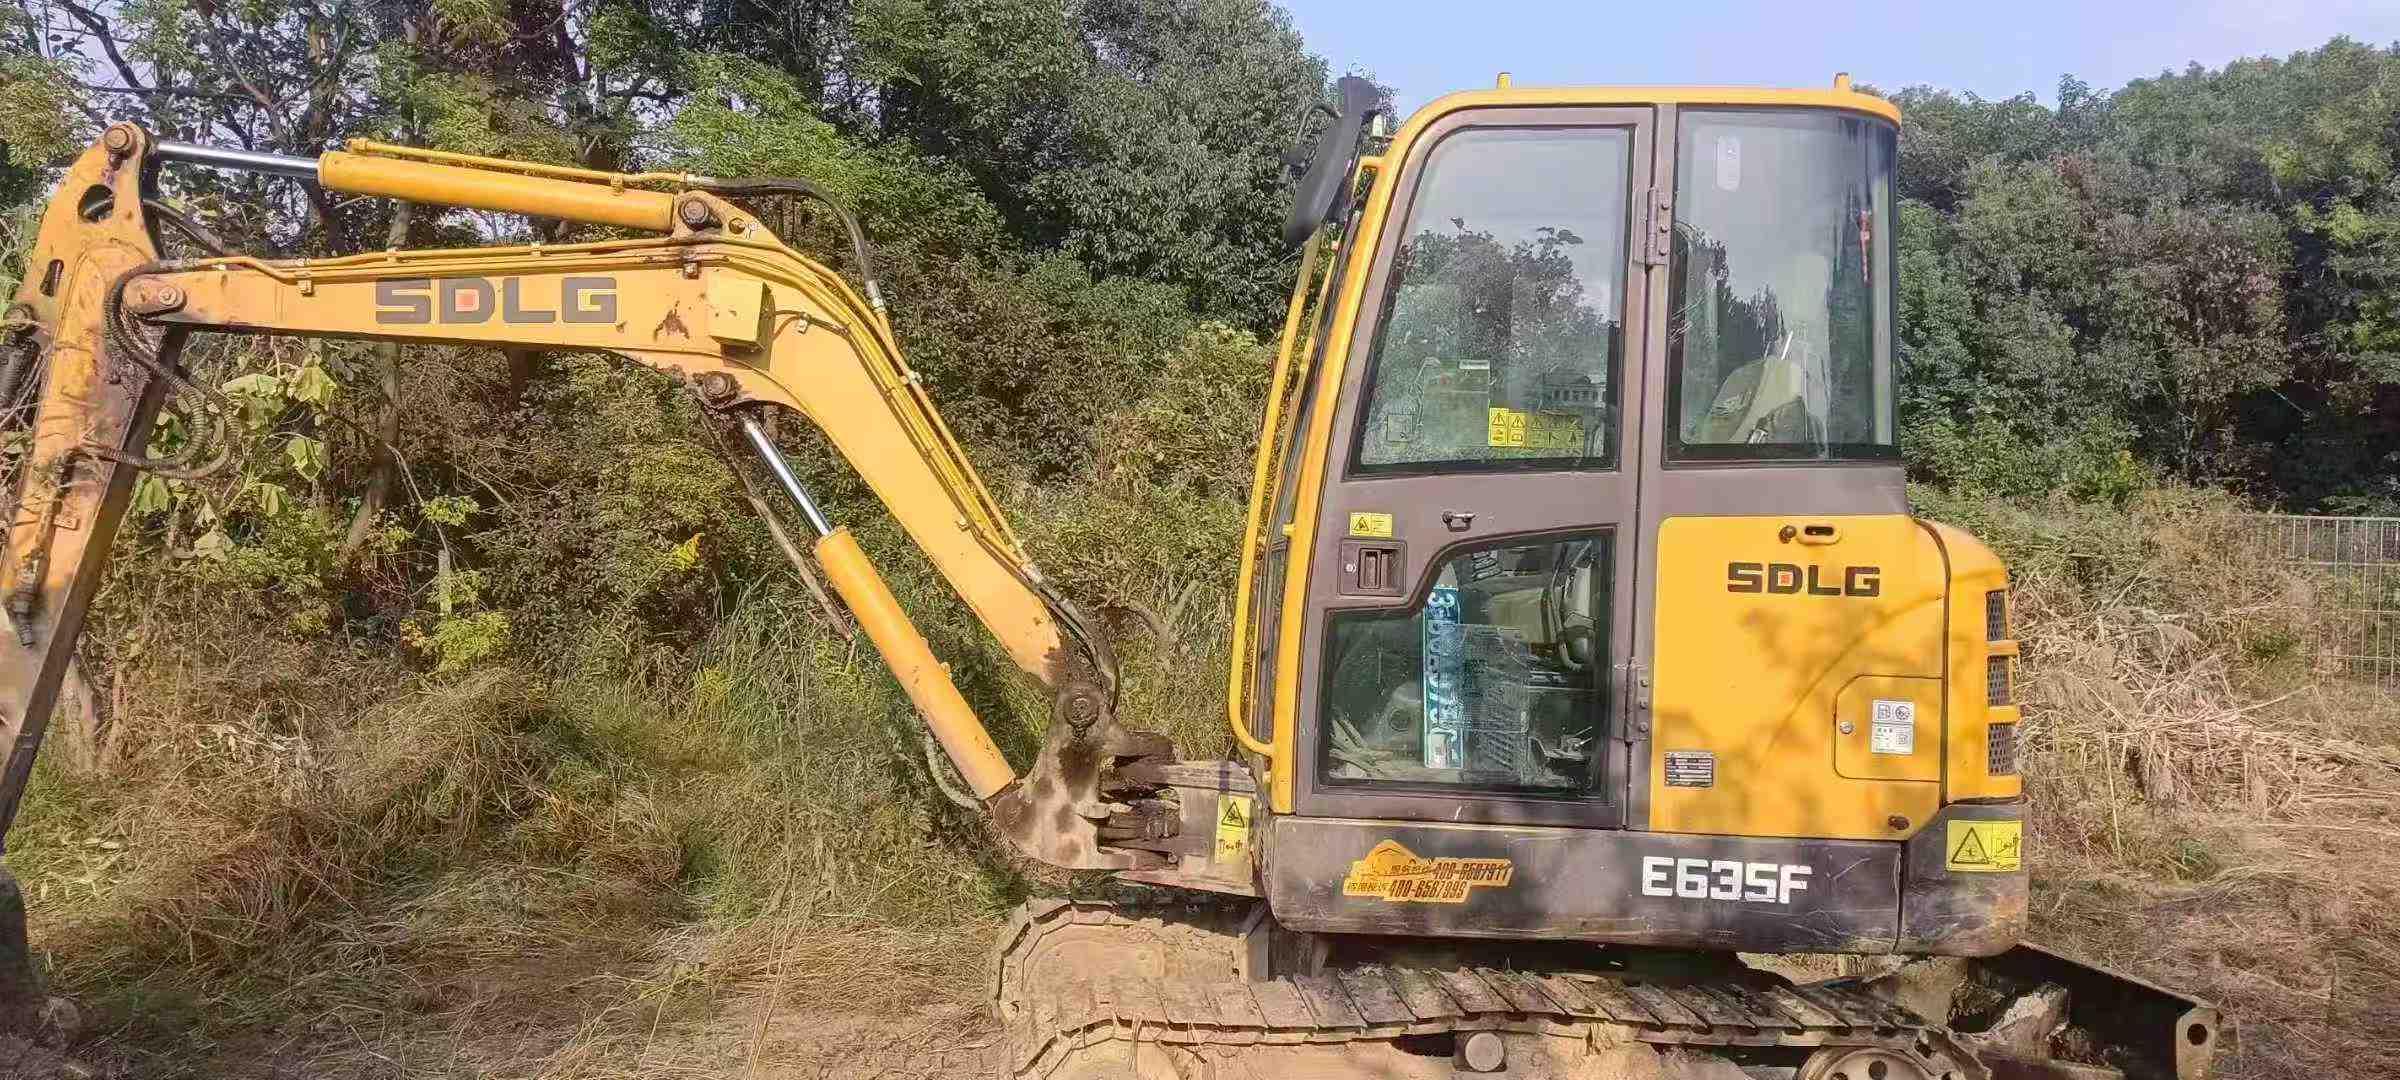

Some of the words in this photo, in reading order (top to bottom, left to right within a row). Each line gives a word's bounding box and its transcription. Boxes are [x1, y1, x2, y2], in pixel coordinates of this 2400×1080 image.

[375, 277, 617, 325] SDLG
[1727, 561, 1881, 597] SDLG
[1641, 855, 1813, 905] E635F
